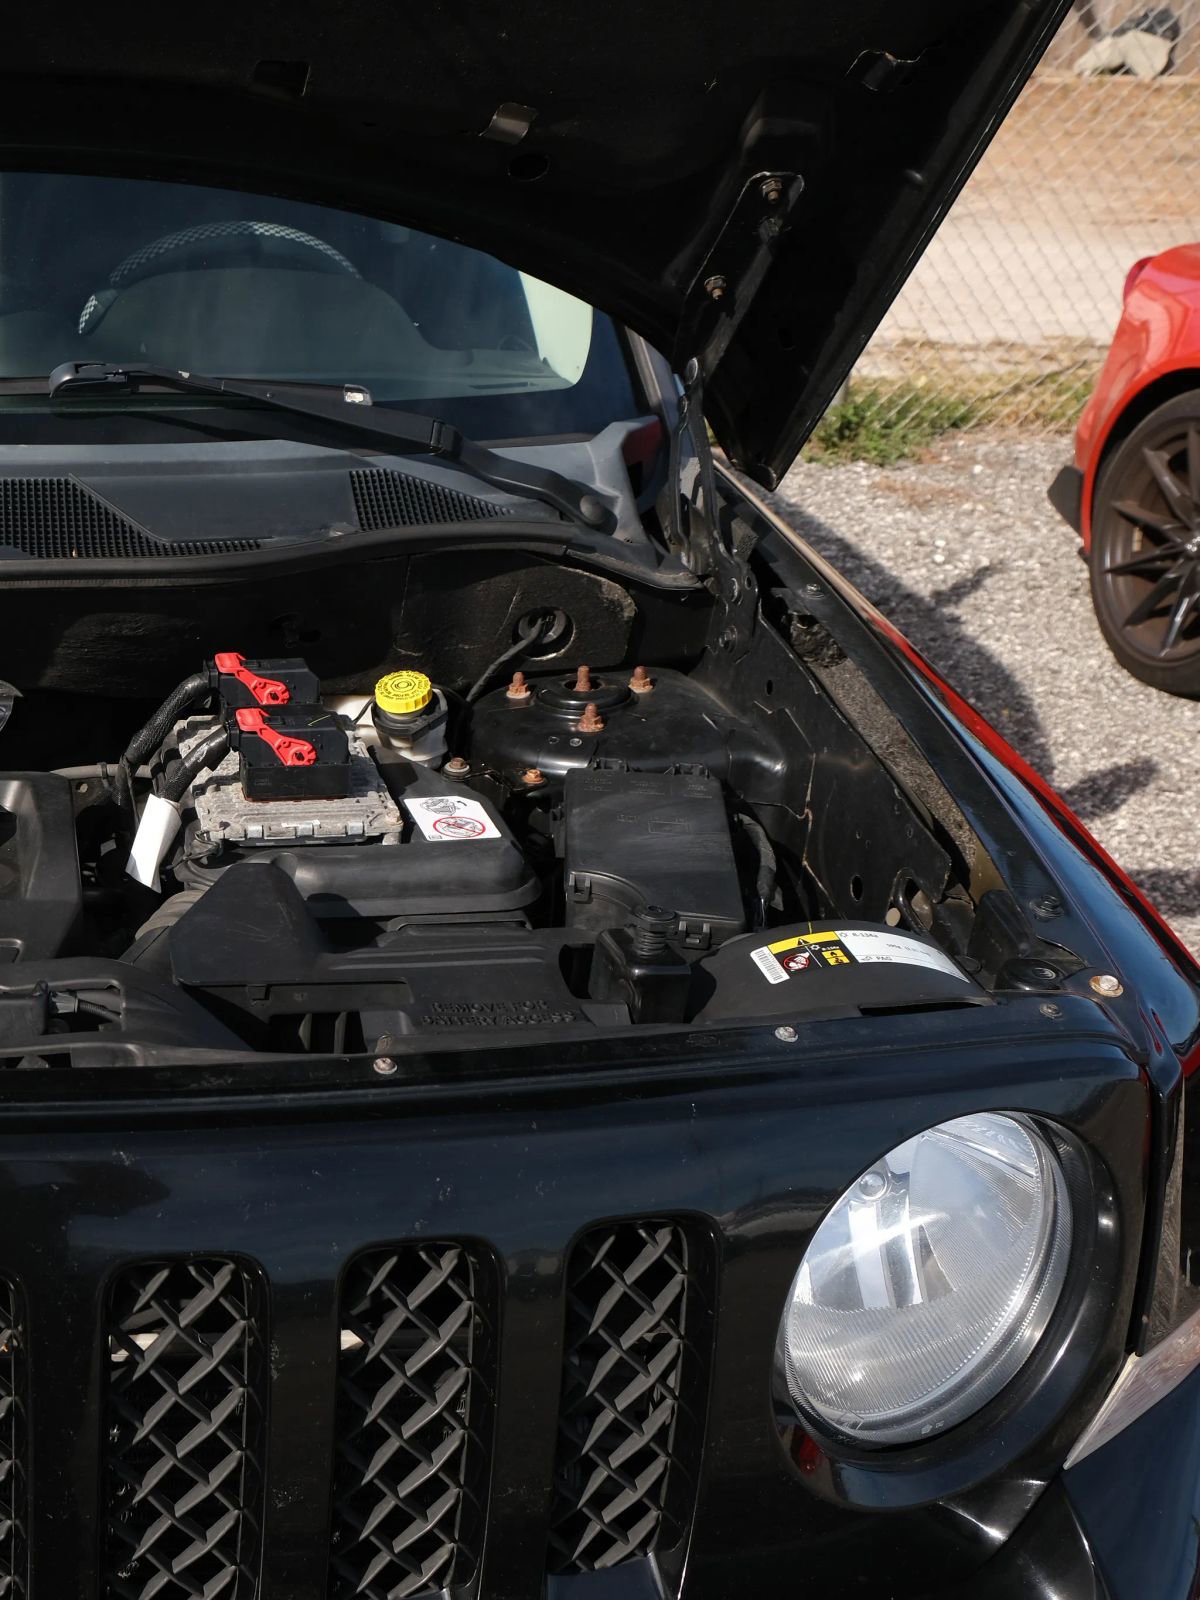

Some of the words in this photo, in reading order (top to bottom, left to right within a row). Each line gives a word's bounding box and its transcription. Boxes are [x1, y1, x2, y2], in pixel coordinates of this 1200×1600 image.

[431, 1000, 508, 1013] REMOVE
[510, 999, 549, 1011] FOR
[421, 1014, 497, 1026] BATTERY
[502, 1011, 577, 1025] ACCESS
